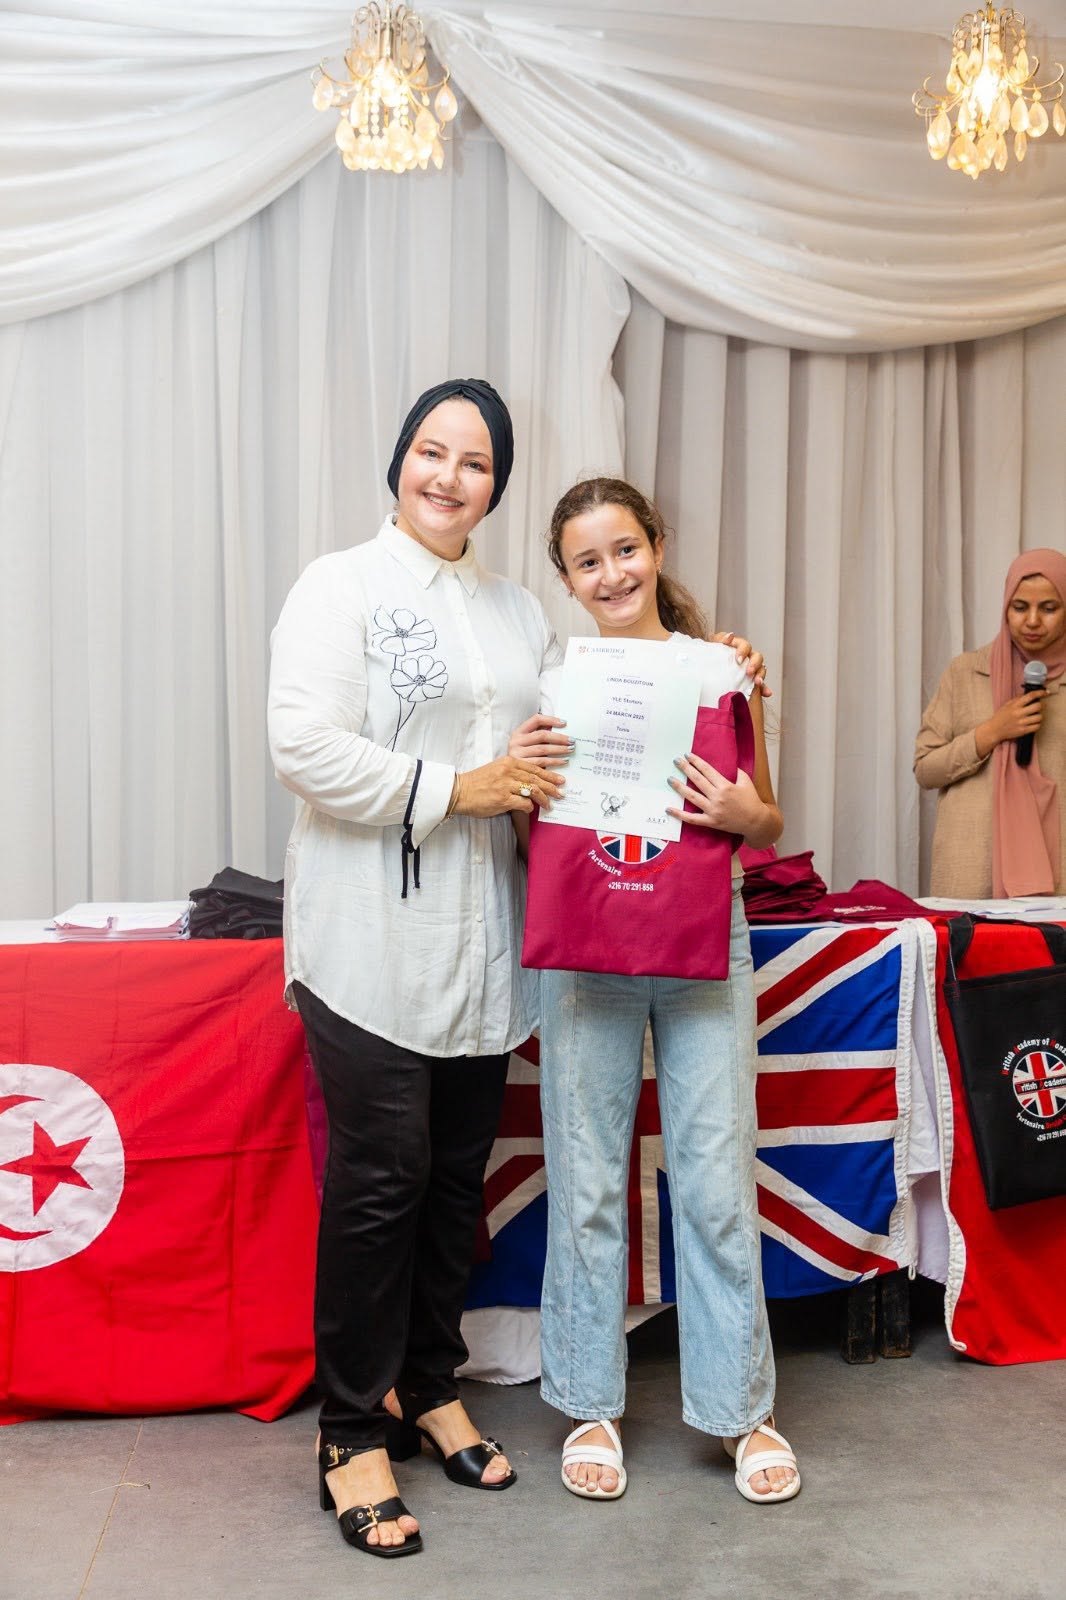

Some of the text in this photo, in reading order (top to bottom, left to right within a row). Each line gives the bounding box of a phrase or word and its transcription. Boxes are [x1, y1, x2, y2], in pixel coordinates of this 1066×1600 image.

[588, 849, 622, 877] Partenaire
[607, 881, 621, 890] +216
[622, 882, 630, 891] 70
[1001, 1051, 1016, 1076] British
[1013, 1039, 1041, 1055] Academy
[1042, 1038, 1050, 1046] of
[1016, 1082, 1038, 1094] British
[1016, 1112, 1045, 1130] Partenaire
